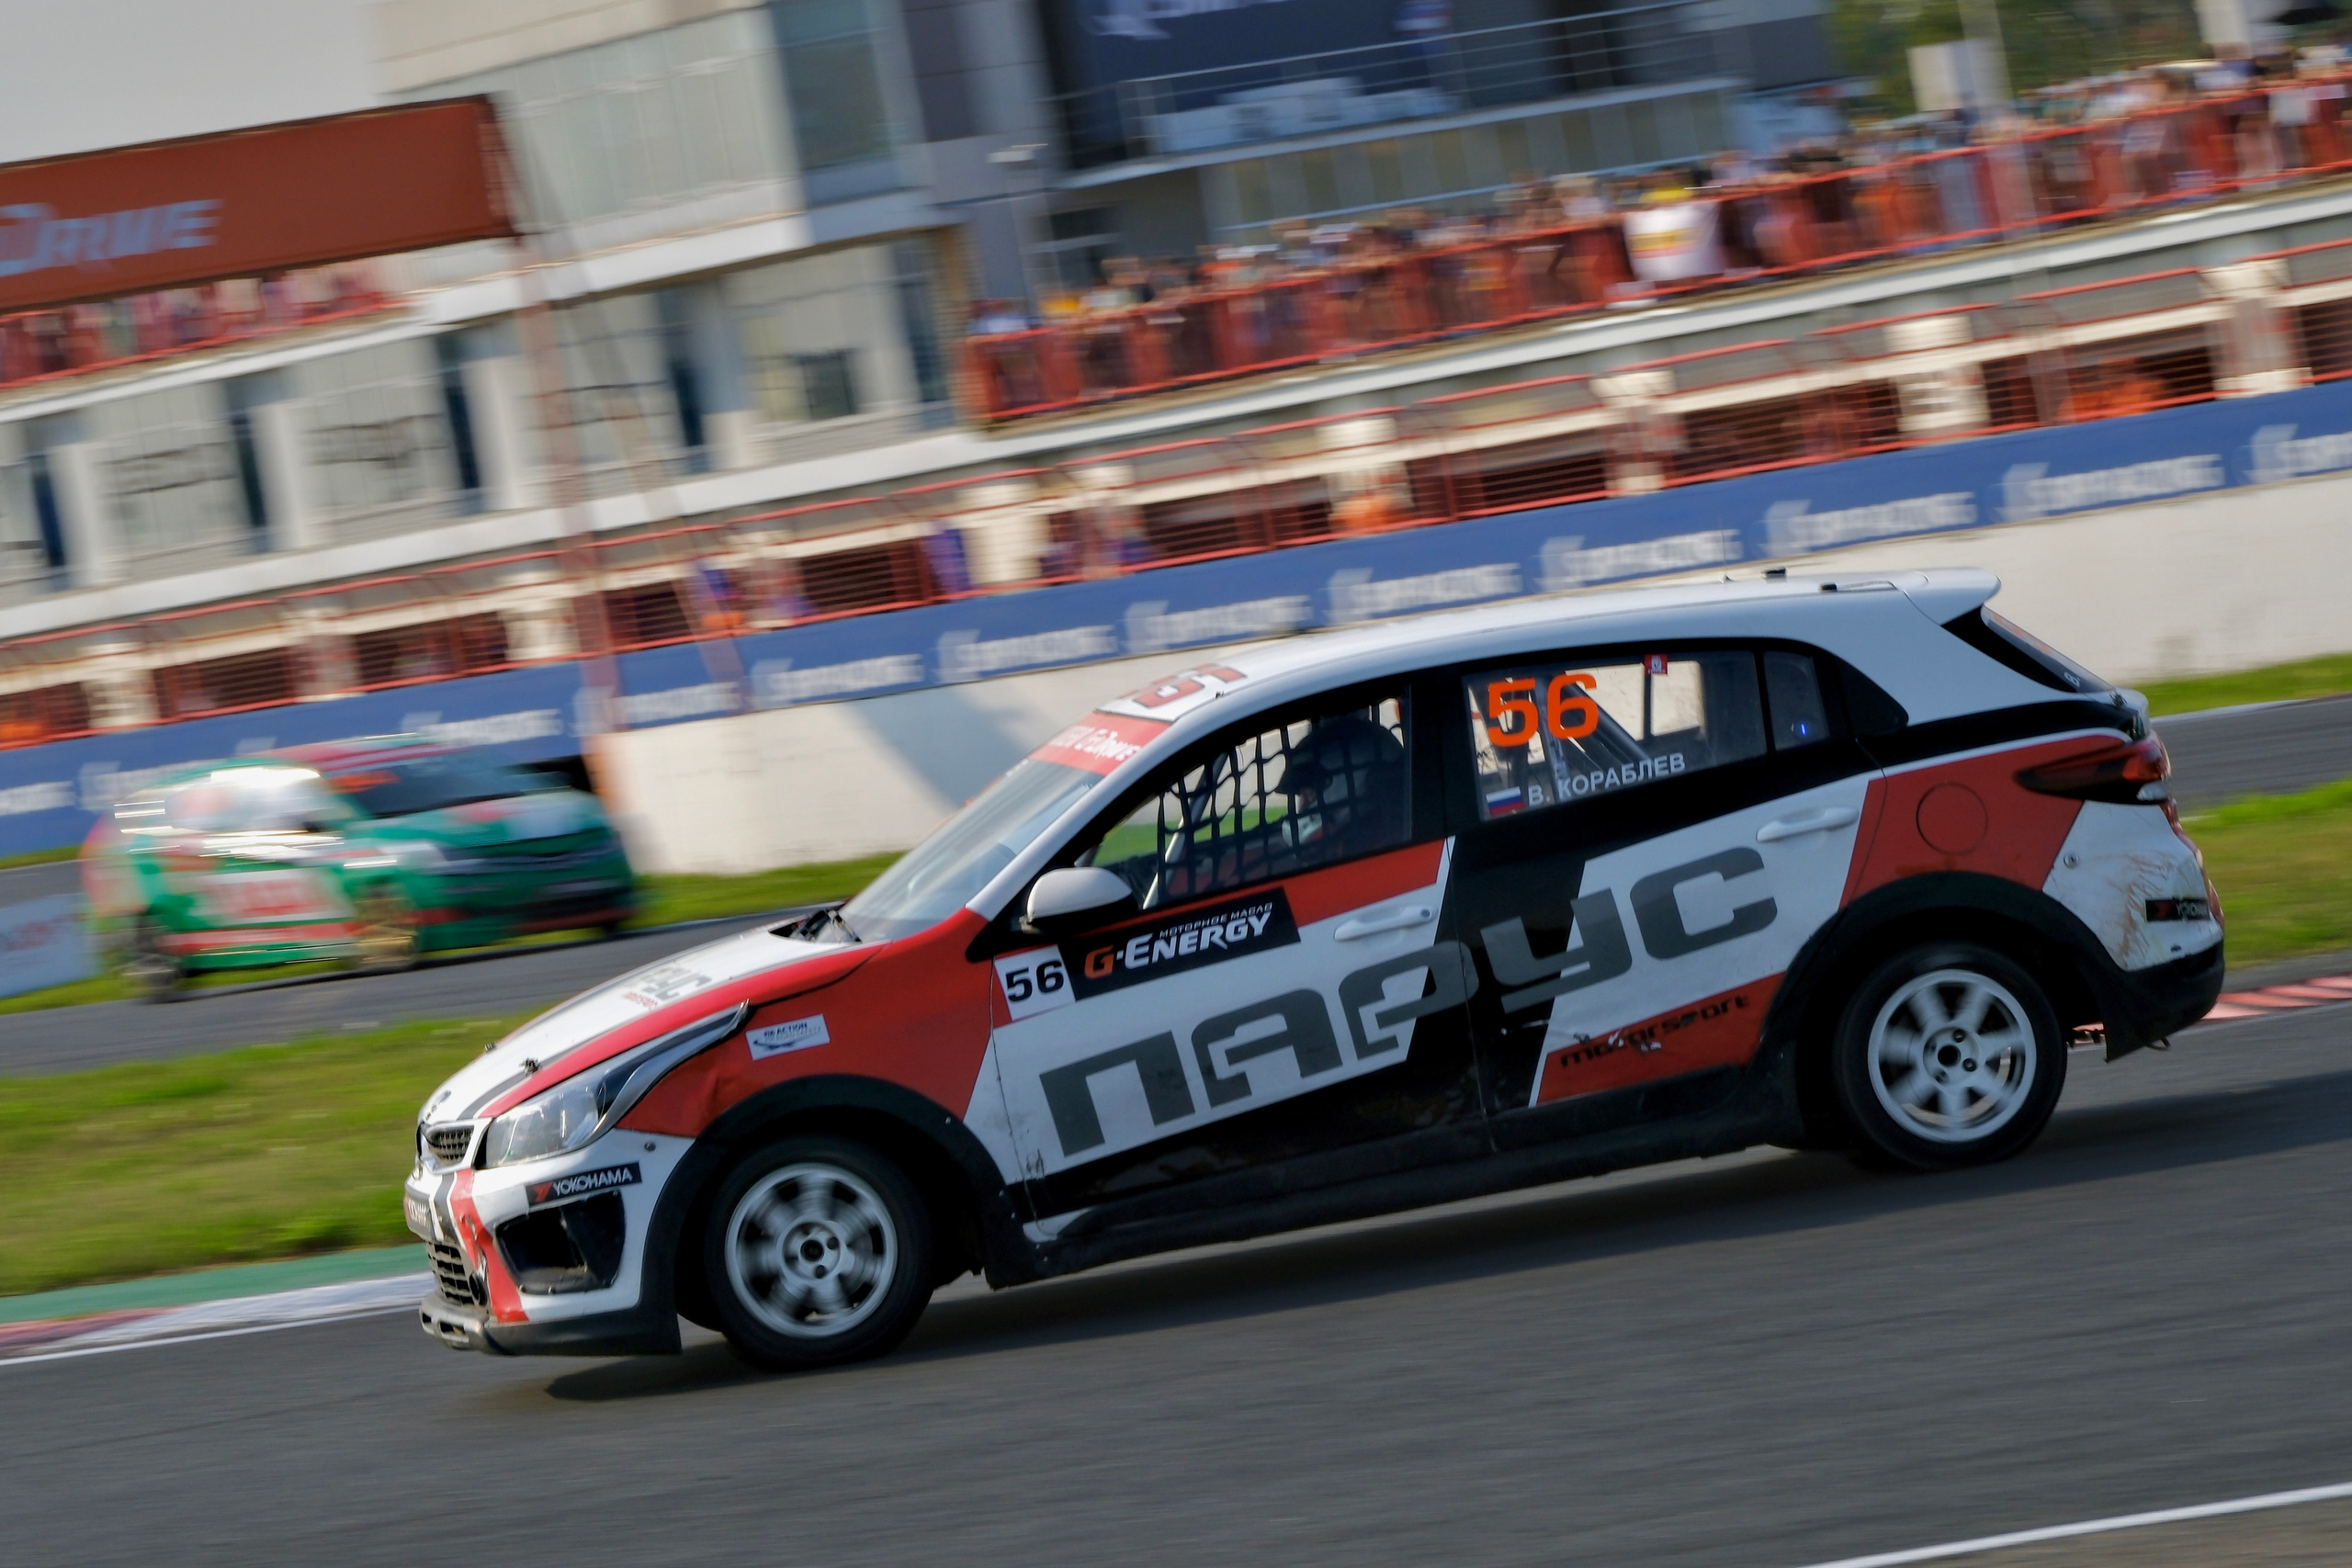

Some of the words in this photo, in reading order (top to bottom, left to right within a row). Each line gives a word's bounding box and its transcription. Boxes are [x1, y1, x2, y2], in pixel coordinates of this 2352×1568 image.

[1487, 672, 1600, 747] 56
[1527, 785, 1551, 807] В.
[1557, 752, 1686, 799] КОРАБЛЕВ
[1005, 960, 1064, 1003] 56
[552, 1167, 633, 1197] YOKOHAMA
